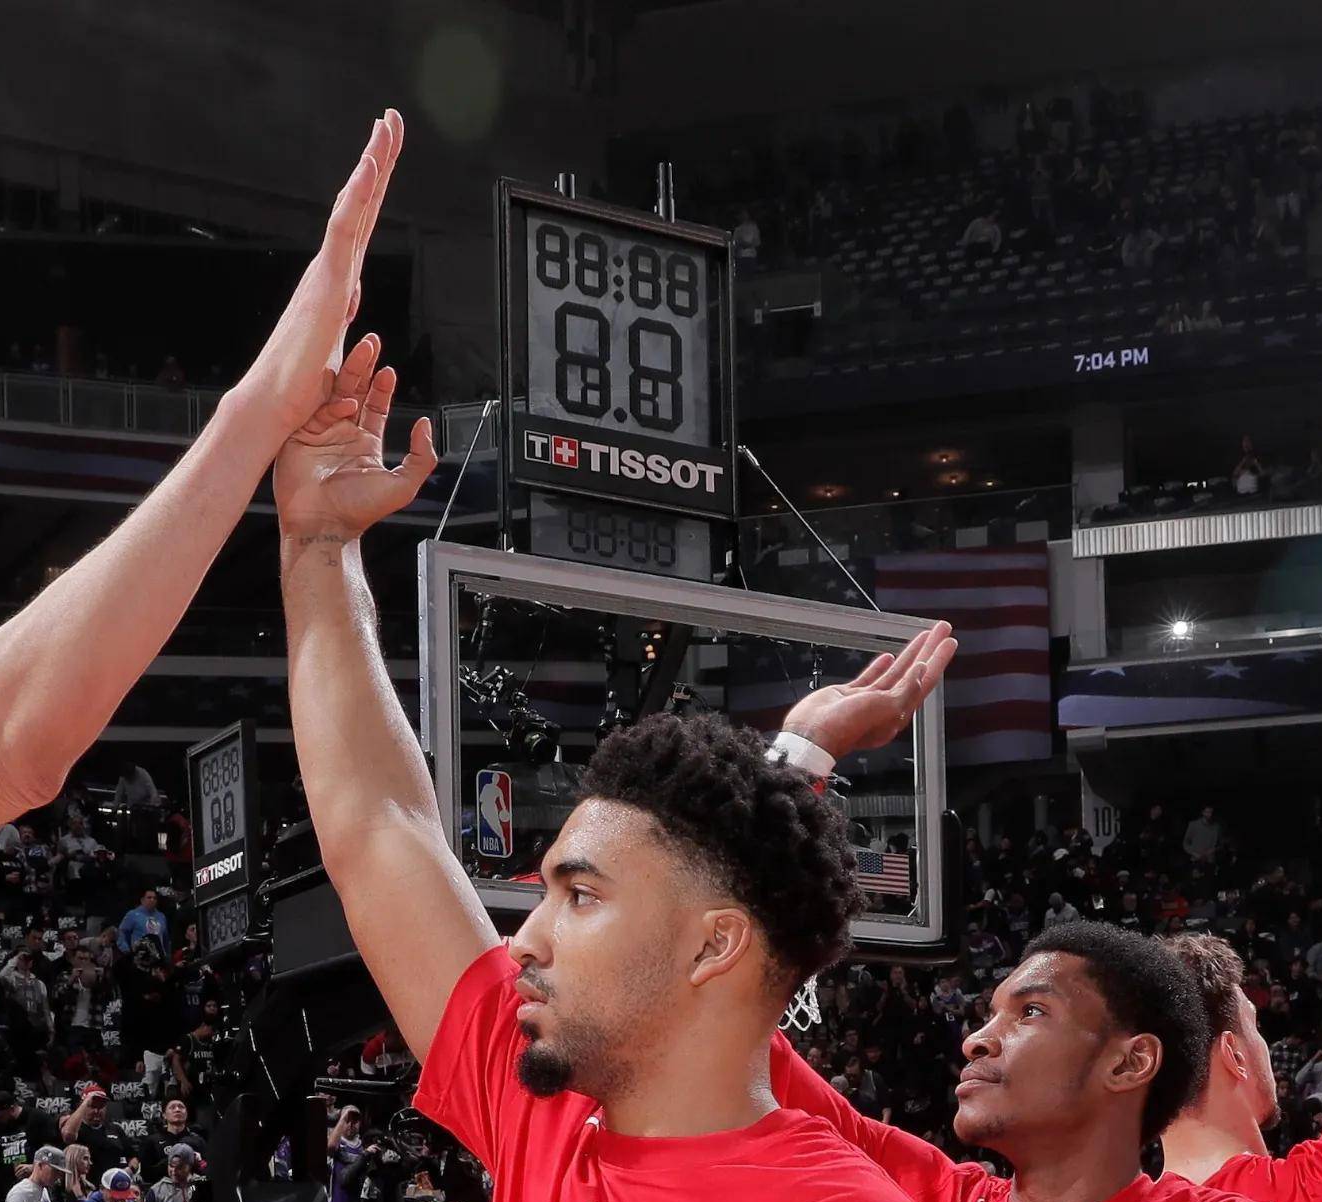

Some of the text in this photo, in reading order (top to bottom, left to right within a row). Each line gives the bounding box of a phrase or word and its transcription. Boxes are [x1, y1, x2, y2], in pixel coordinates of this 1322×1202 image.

[1073, 346, 1149, 372] 7:04 PM
[581, 442, 724, 493] TISSOT
[482, 836, 500, 852] NBA
[208, 851, 245, 881] TISSOT
